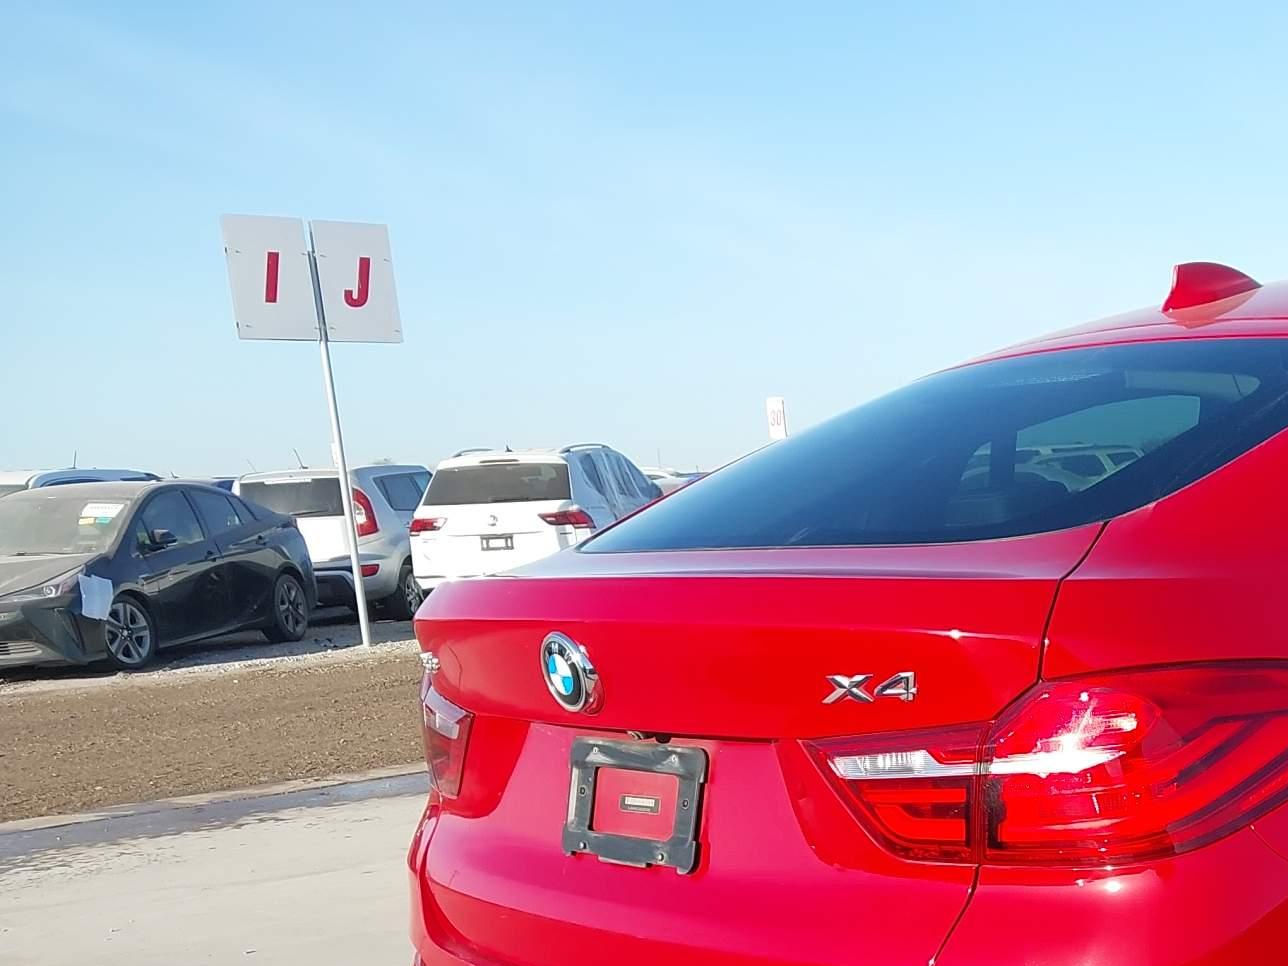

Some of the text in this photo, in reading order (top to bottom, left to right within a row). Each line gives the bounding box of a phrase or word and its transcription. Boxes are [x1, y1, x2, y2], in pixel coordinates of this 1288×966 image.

[264, 251, 280, 304] I
[343, 256, 372, 309] J
[821, 671, 918, 704] X4
